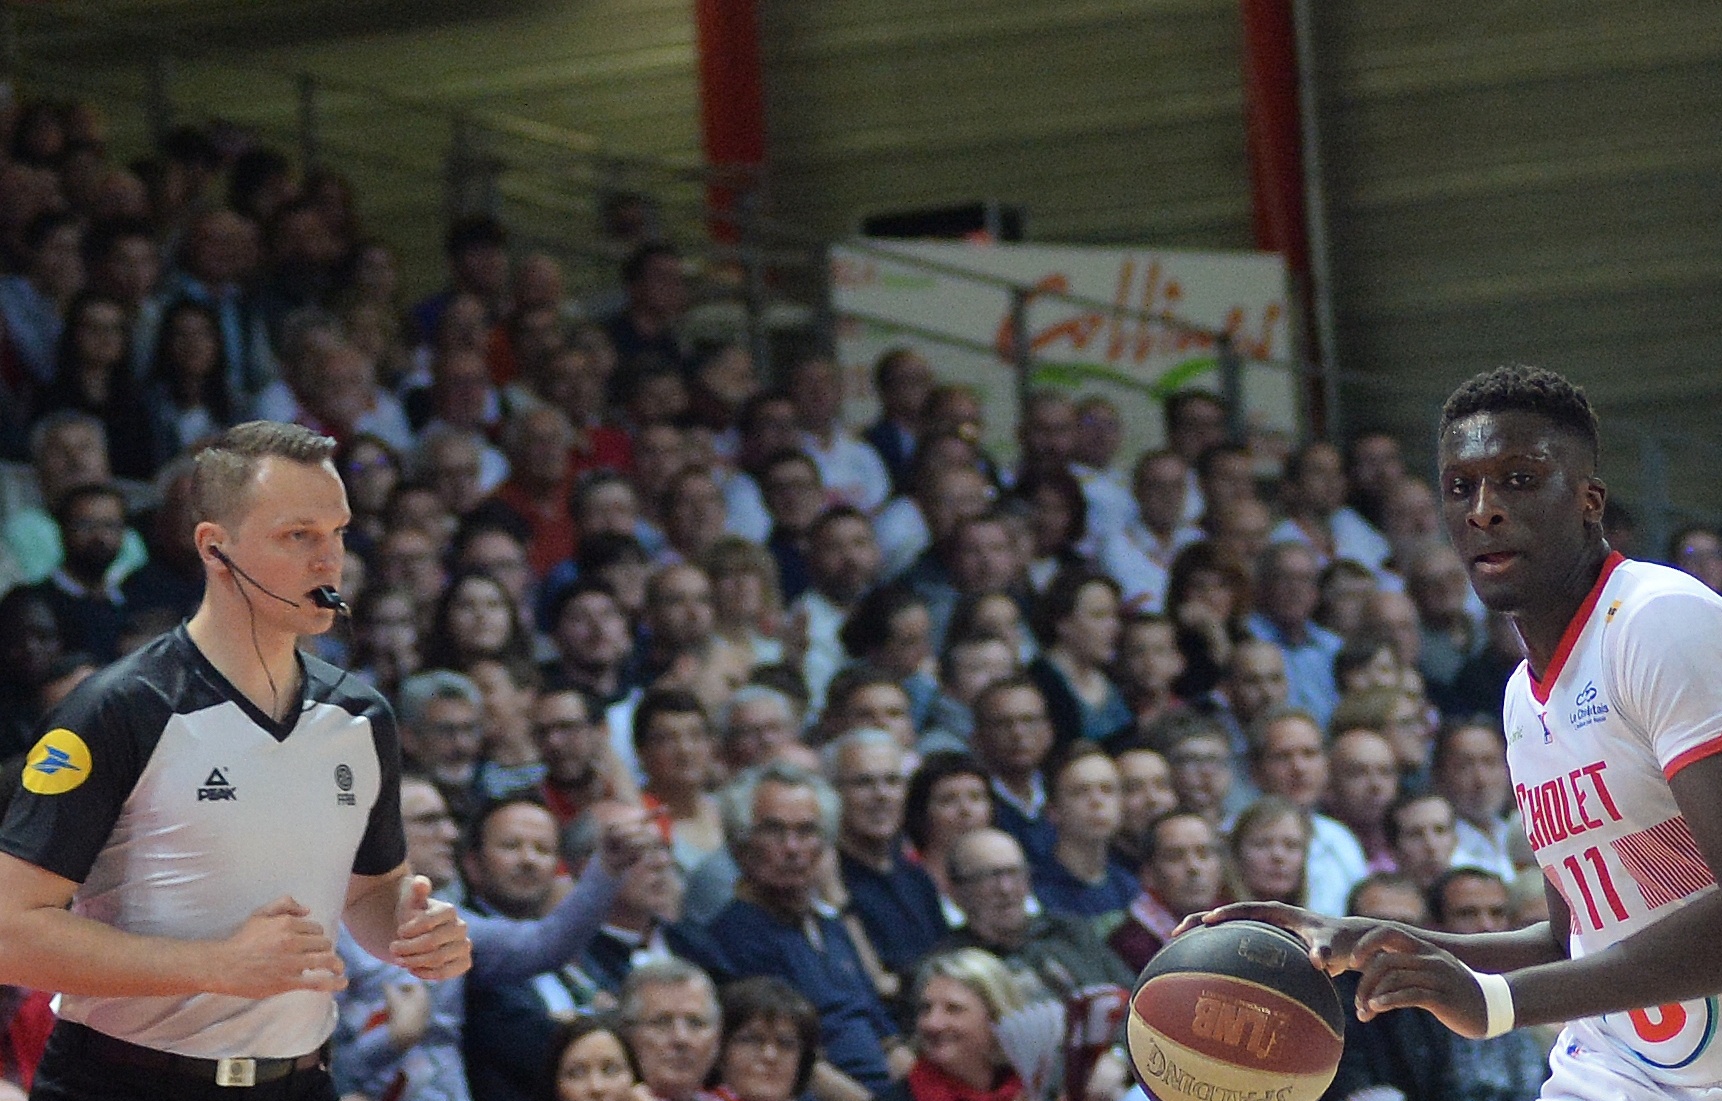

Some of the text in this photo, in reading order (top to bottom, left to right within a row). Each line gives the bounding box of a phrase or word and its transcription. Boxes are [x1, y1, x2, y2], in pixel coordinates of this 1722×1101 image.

[197, 786, 237, 802] PEAK
[1515, 760, 1624, 852] CHOLET
[1562, 846, 1630, 931] 11
